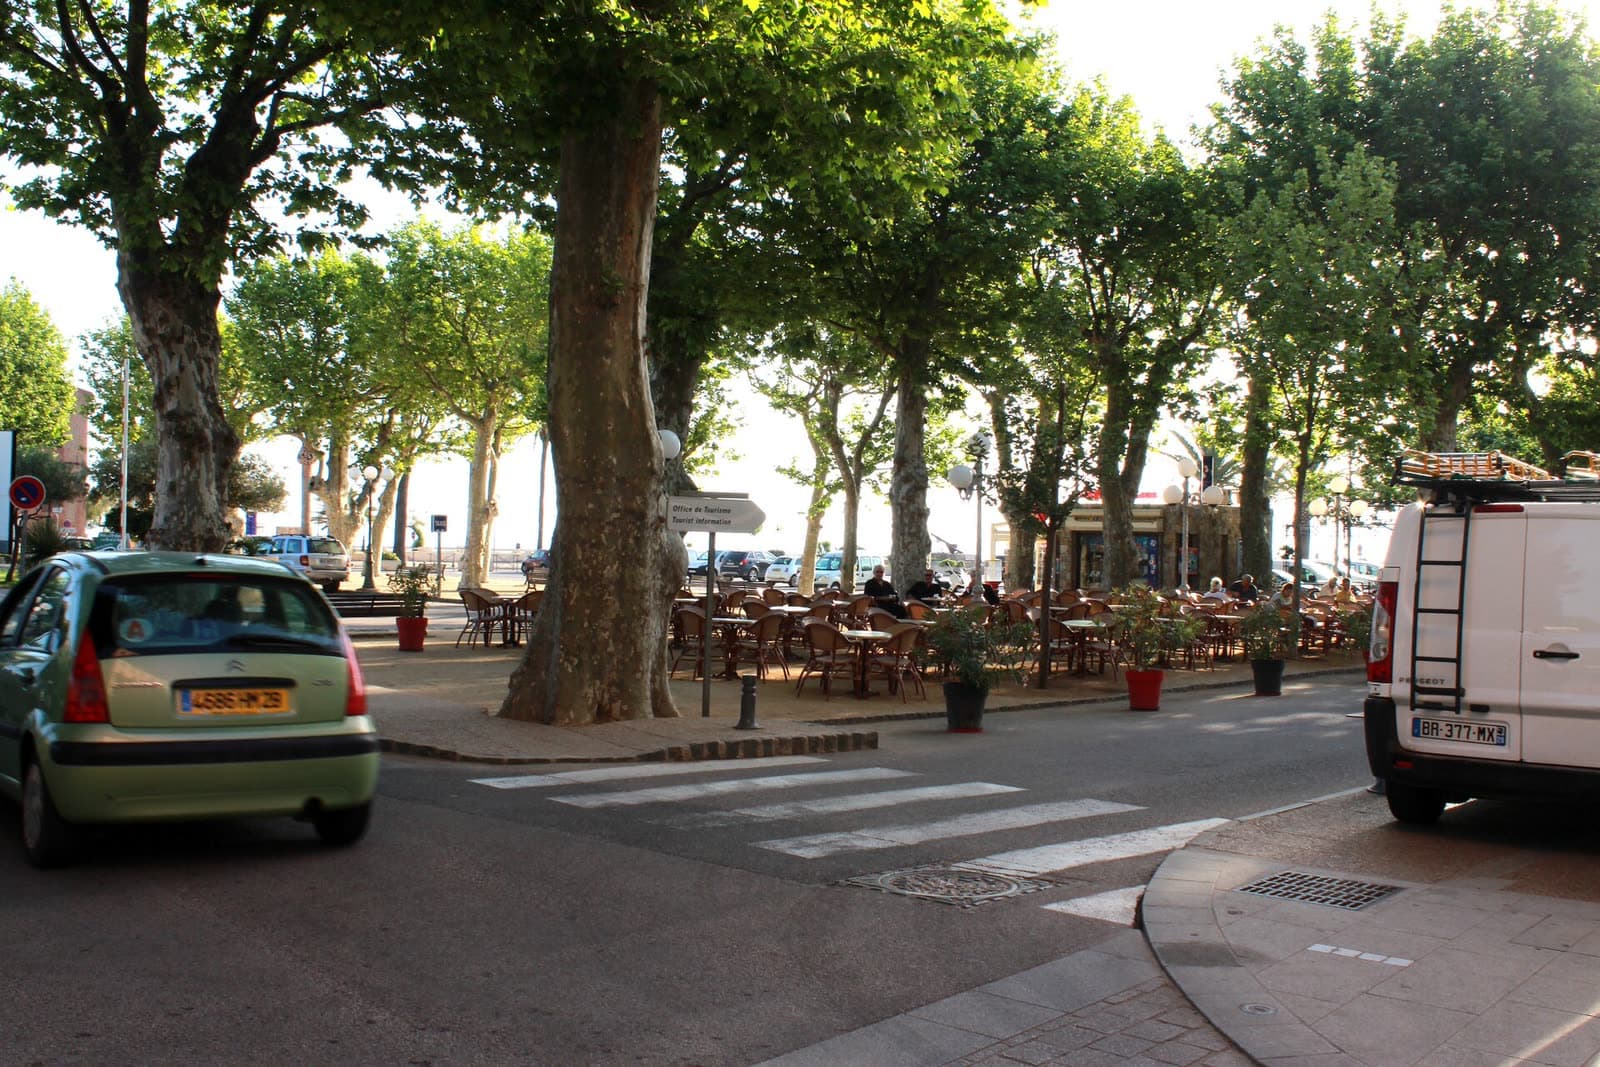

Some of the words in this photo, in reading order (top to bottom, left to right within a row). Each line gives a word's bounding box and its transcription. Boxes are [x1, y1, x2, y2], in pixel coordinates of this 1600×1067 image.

[672, 504, 692, 513] Office
[704, 506, 731, 514] Tourisme
[672, 516, 694, 525] Tourist
[1398, 677, 1446, 685] PEGEOT
